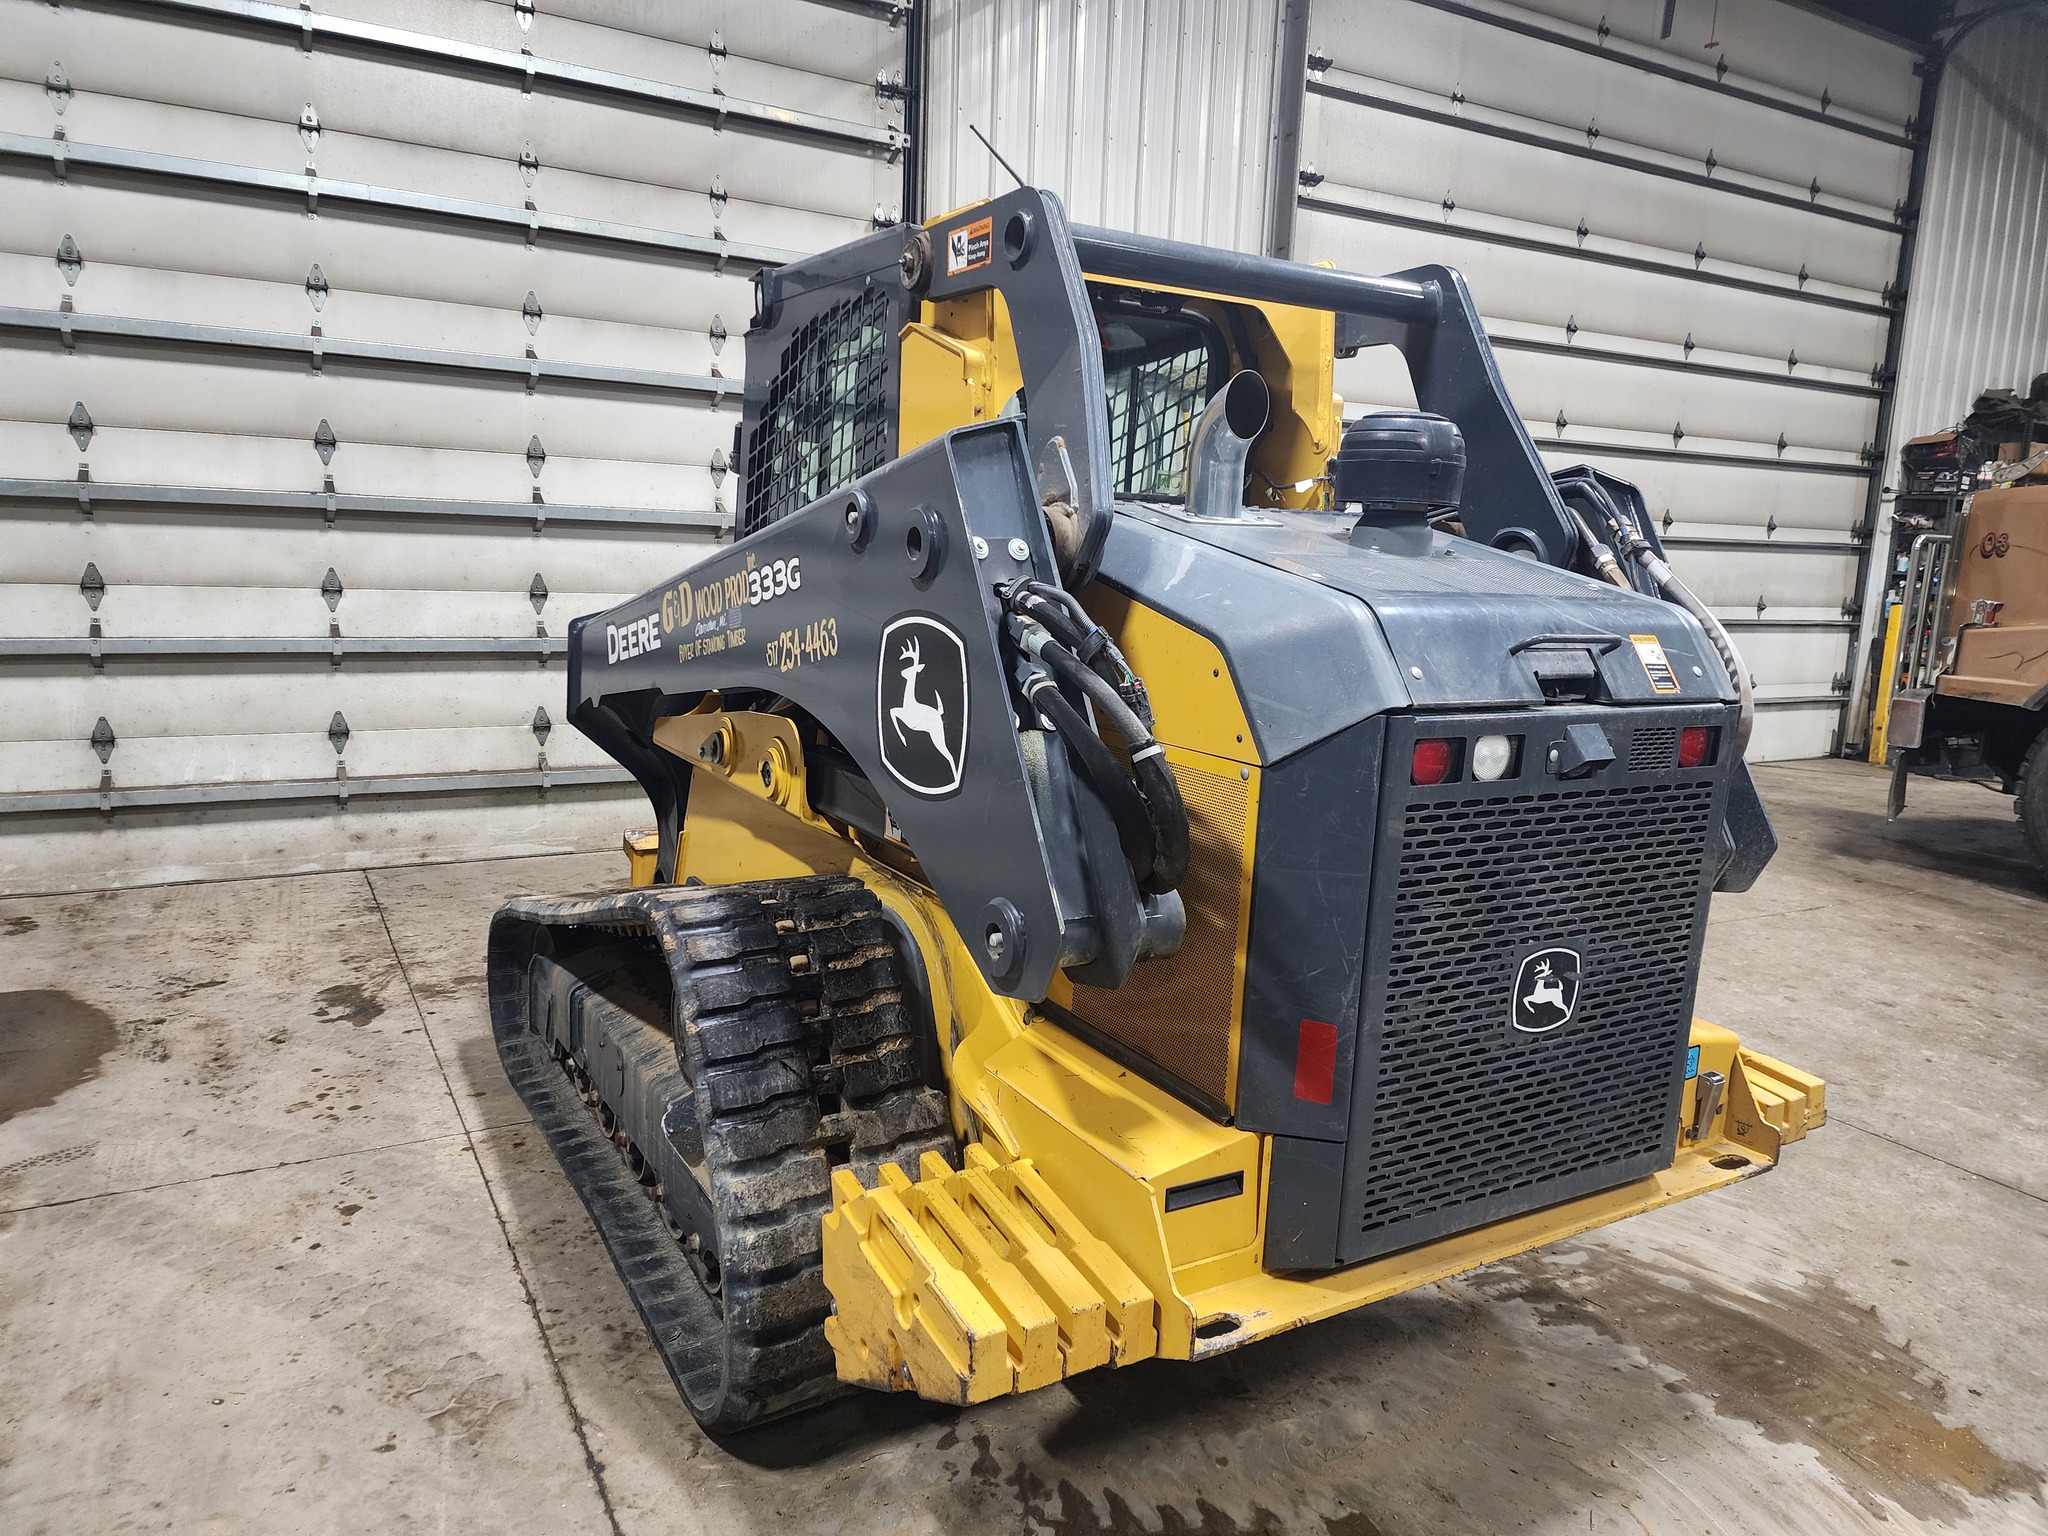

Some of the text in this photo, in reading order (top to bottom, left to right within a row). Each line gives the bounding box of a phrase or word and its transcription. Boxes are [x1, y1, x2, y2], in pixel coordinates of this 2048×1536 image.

[1979, 531, 2011, 559] 03
[749, 557, 801, 606] 333G
[662, 580, 694, 634] G&D
[695, 581, 723, 620] WOOD
[606, 612, 662, 665] DEERE
[695, 637, 702, 658] OF
[702, 632, 726, 656] STANDING
[727, 627, 747, 649] TIMBER
